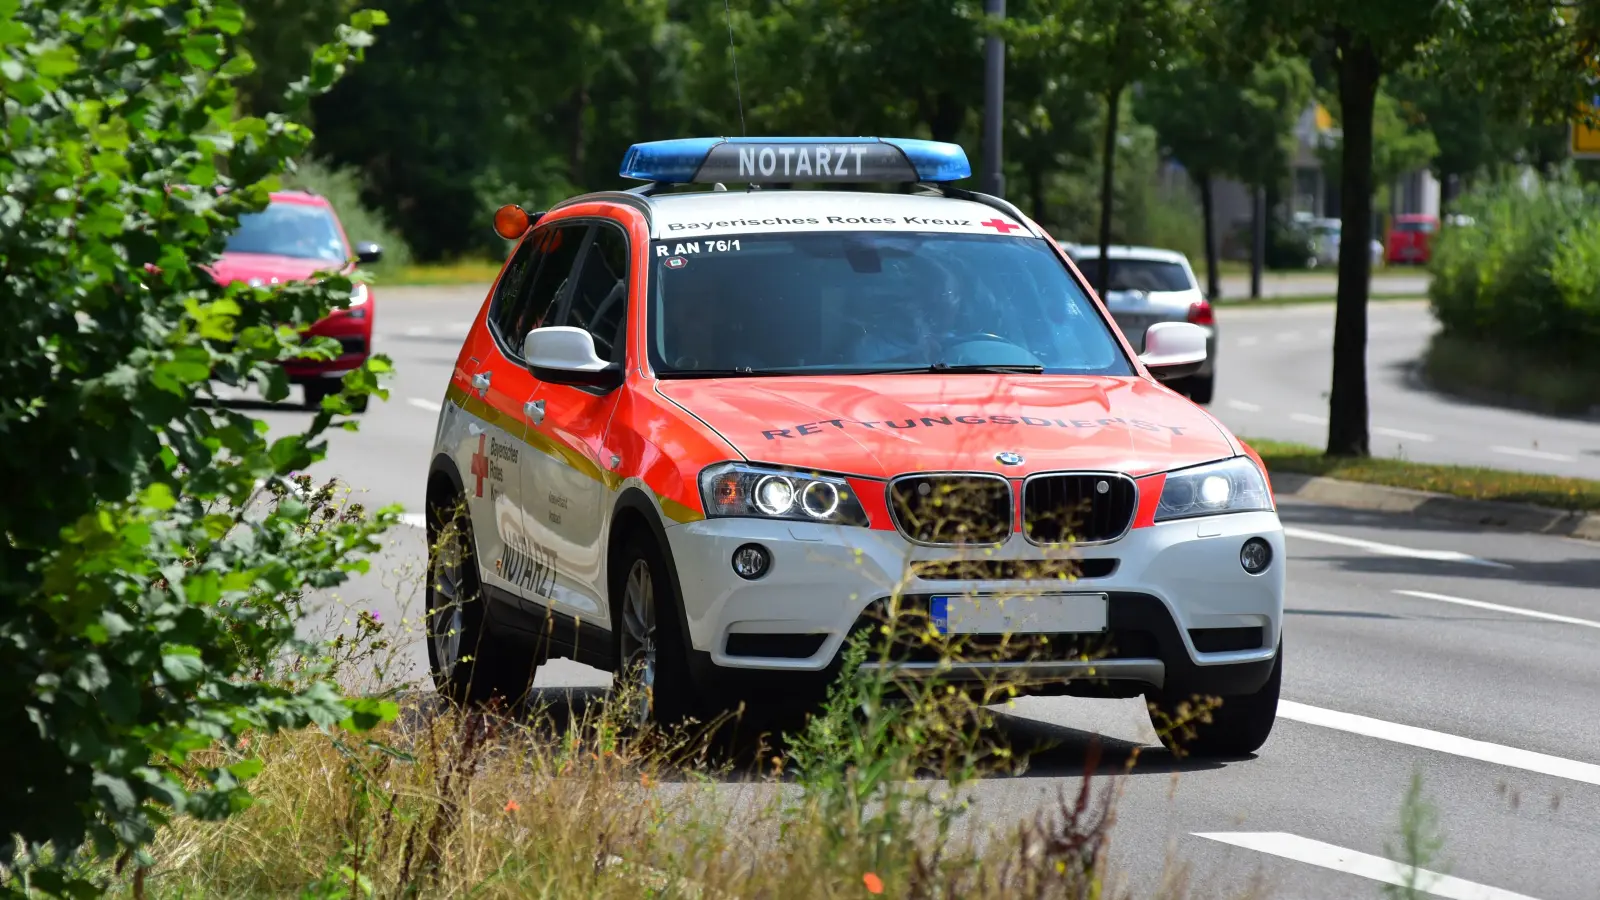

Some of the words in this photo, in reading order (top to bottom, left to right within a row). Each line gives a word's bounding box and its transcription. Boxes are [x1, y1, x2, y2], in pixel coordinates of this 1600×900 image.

[739, 147, 867, 176] NOTARZT
[667, 216, 820, 231] Bayerisches
[826, 216, 897, 225] Rotes
[902, 216, 972, 227] Kreuz
[656, 245, 670, 257] R
[674, 241, 701, 255] AN
[704, 239, 741, 253] 76/1
[761, 415, 1186, 440] RETTUNGSDIENST
